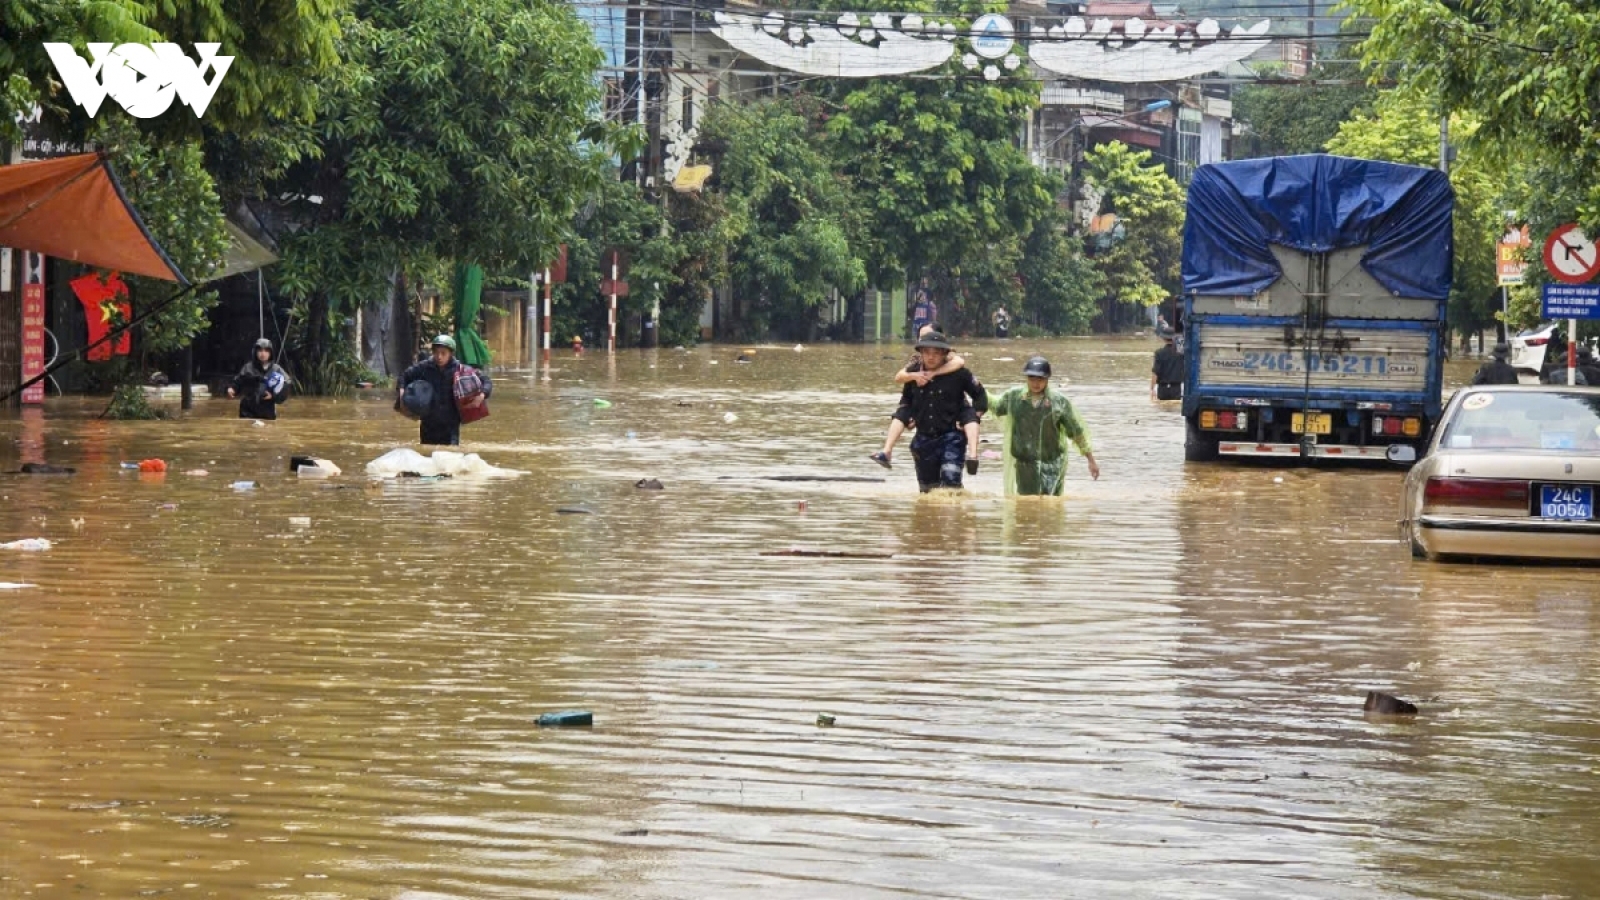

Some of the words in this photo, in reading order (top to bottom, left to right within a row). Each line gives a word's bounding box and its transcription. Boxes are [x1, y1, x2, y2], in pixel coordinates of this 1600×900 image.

[1211, 360, 1244, 368] THACO
[1552, 487, 1582, 503] 24C
[1547, 503, 1586, 517] 0054
